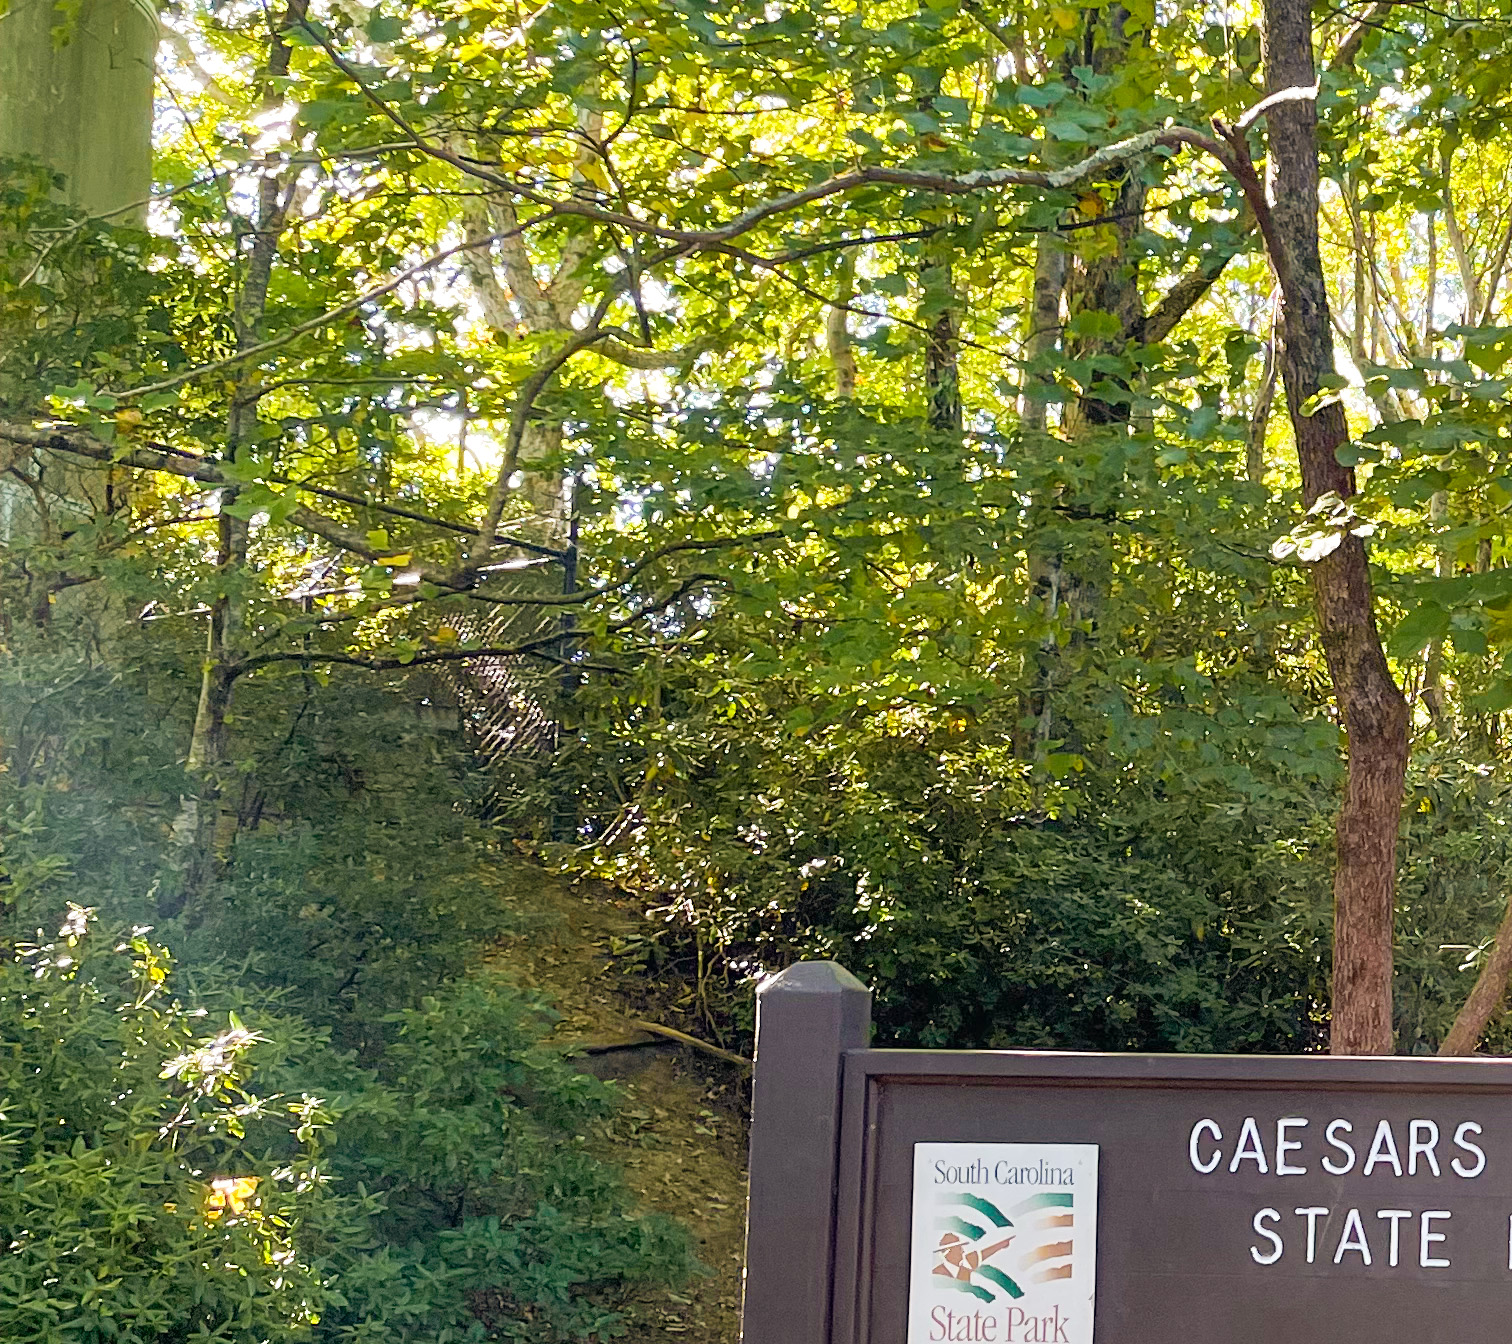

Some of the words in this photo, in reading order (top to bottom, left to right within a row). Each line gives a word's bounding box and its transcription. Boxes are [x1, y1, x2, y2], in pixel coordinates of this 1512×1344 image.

[934, 1158, 989, 1185] South
[994, 1158, 1075, 1186] Carolina
[1189, 1117, 1486, 1178] CAESARS
[1250, 1206, 1452, 1268] STATE
[929, 1305, 998, 1343] State
[1005, 1304, 1070, 1344] Park
